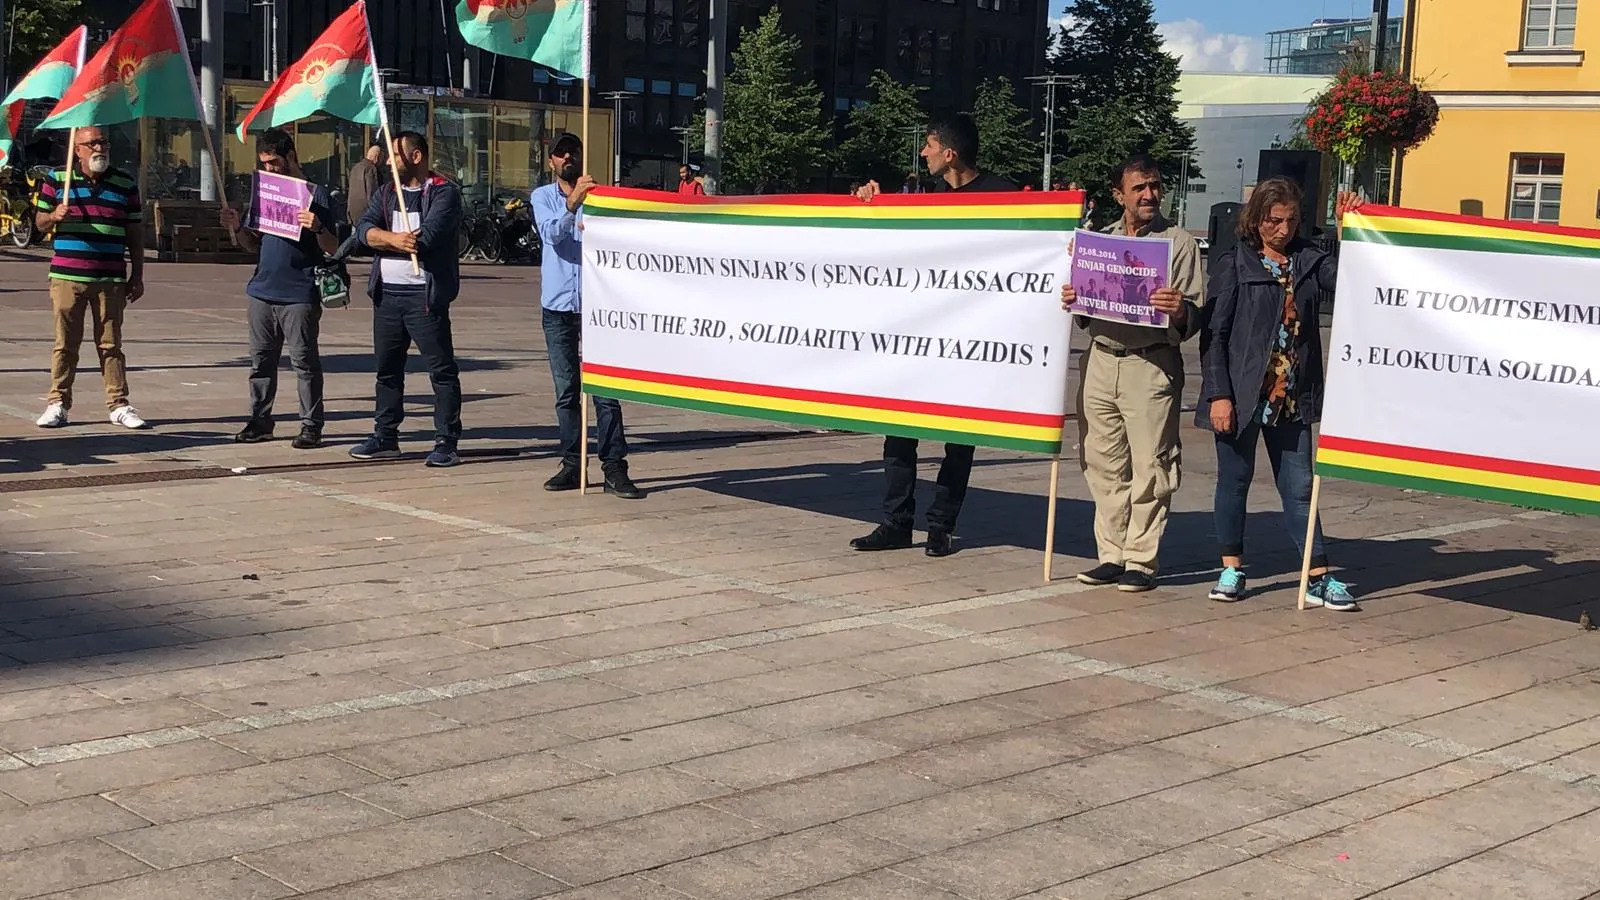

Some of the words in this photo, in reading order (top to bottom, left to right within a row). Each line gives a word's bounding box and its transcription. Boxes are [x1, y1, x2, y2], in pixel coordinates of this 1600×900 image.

[1077, 258, 1105, 272] SINJAR
[1106, 264, 1158, 277] GENOCIDE
[1078, 246, 1117, 260] 03.08.2014
[596, 249, 622, 268] WE
[626, 251, 715, 276] CONDEMN
[924, 268, 1055, 294] MASSACRE
[1077, 296, 1108, 311] NEVER
[1109, 301, 1156, 316] FORGET!
[1374, 286, 1409, 307] ME
[1416, 290, 1600, 326] TUOMITSEMM
[589, 308, 648, 332] AUGUST
[652, 313, 687, 336] THE
[739, 322, 866, 352] SOLIDARITY
[870, 332, 933, 357] WITH
[1368, 346, 1493, 377] ELOKUUTA
